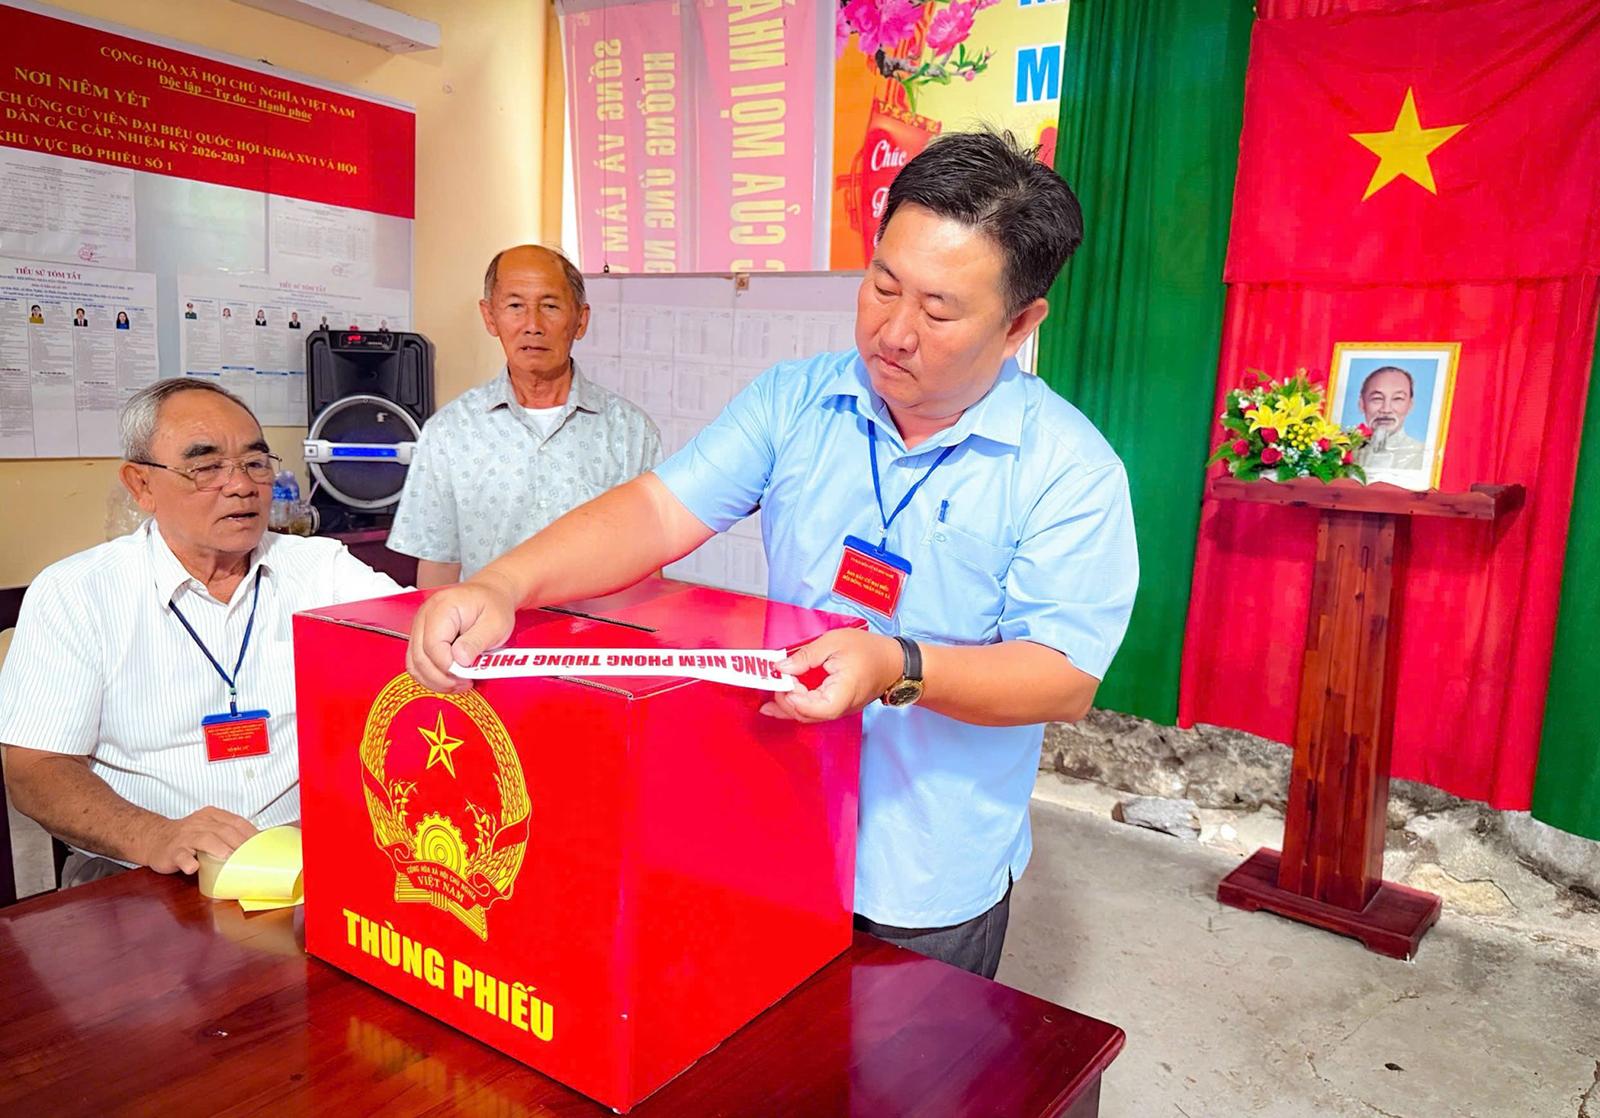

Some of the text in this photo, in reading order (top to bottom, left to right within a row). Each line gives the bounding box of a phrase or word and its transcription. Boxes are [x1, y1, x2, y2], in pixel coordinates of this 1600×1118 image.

[14, 66, 151, 109] NƠI NIÊM YẾT
[100, 46, 356, 119] CỘNG HÒA XÃ HỘI CHỦ NGHĨA VIỆT NAM
[159, 74, 181, 89] Độc
[184, 80, 202, 96] lập
[214, 88, 230, 101] Tự
[233, 93, 246, 104] do
[258, 98, 286, 114] Hạnh
[288, 107, 313, 120] phúc
[6, 107, 40, 124] DÂN
[44, 116, 78, 131] CÁC
[118, 130, 165, 149] NHIỆM
[169, 140, 189, 153] KỲ
[192, 145, 246, 165] 2026-2031
[27, 94, 62, 113] ỨNG
[66, 104, 90, 119] CỬ
[93, 110, 128, 126] VIÊN
[132, 118, 157, 134] ĐẠI
[161, 124, 193, 140] BIỂU
[195, 131, 234, 148] QUỐC
[236, 140, 260, 155] HỘI
[296, 153, 317, 166] XVI
[320, 158, 335, 170] VÀ
[337, 161, 358, 175] HỘI
[33, 136, 68, 152] VỰC
[72, 143, 94, 156] BỎ
[97, 148, 141, 165] PHIẾU
[145, 157, 164, 169] SỐ
[167, 161, 172, 171] 1
[871, 139, 908, 172] Chúc
[533, 654, 601, 668] THÙNG
[606, 655, 674, 667] PHONG
[679, 654, 727, 669] NIÊM
[417, 874, 465, 903] VIỆT NAM
[342, 907, 554, 1042] THÙNG PHIẾU
